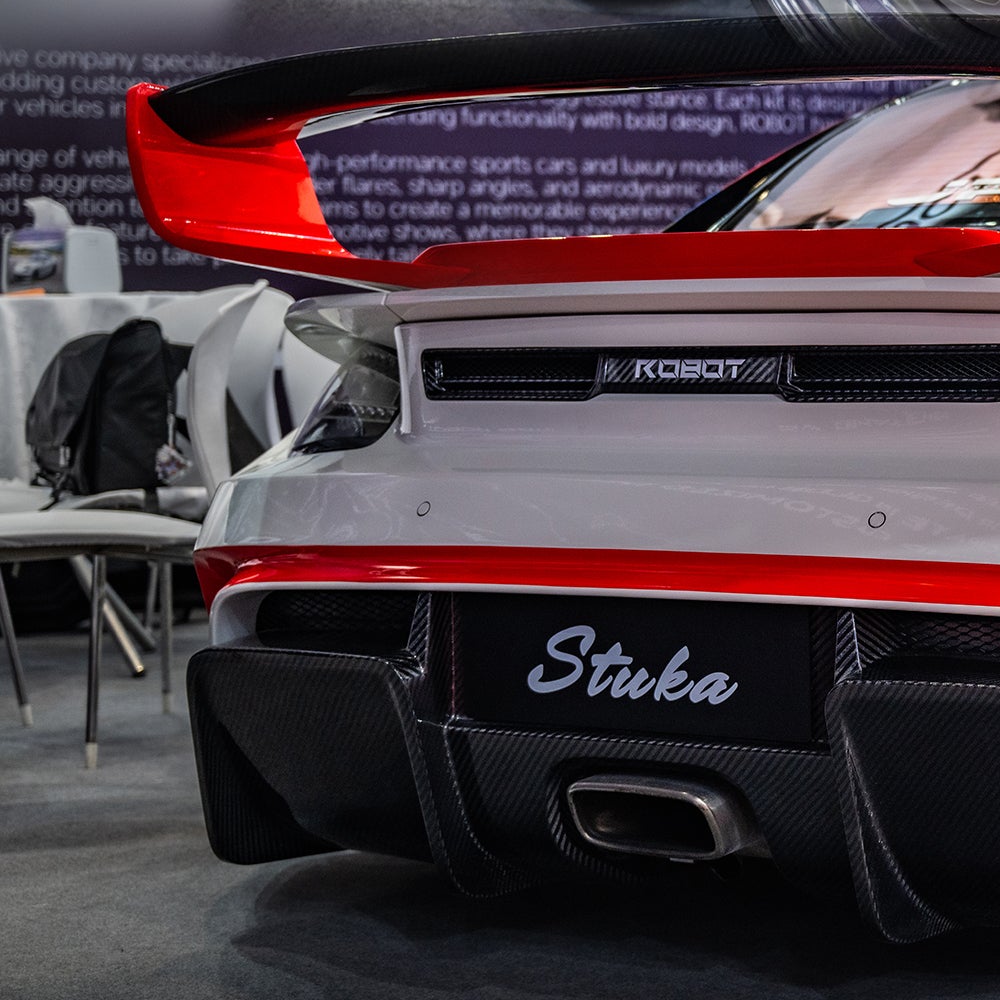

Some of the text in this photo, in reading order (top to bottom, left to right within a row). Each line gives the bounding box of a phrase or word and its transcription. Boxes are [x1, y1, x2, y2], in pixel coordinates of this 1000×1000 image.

[0, 48, 28, 68] ve
[35, 50, 136, 73] company
[763, 87, 785, 111] kit
[14, 95, 104, 118] vehicles
[460, 106, 576, 131] functionality
[580, 110, 622, 130] with
[624, 111, 667, 131] bold
[740, 112, 805, 134] ROBOT
[53, 144, 78, 168] of
[469, 155, 532, 177] sports
[534, 157, 577, 175] cars
[579, 156, 618, 176] and
[620, 155, 676, 179] luxury
[407, 176, 465, 198] sharp
[541, 180, 579, 198] and
[583, 181, 703, 201] aerodynamic
[362, 200, 385, 219] to
[388, 200, 453, 220] create
[473, 201, 586, 221] memorable
[134, 246, 158, 265] to
[634, 358, 746, 380] ROBOT
[527, 624, 739, 705] Stuka
